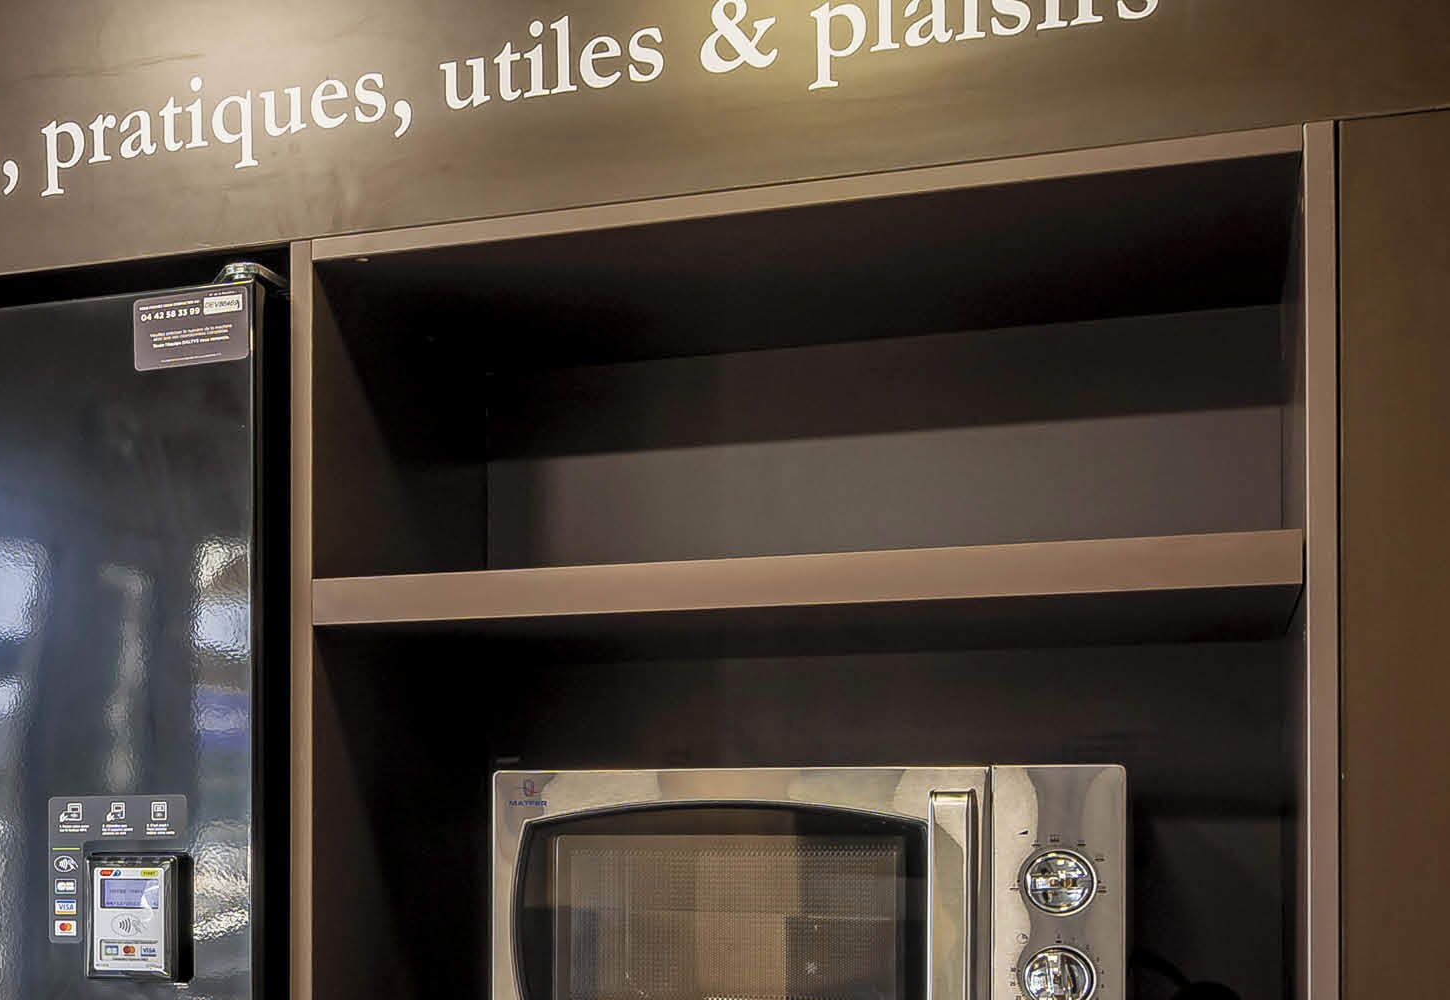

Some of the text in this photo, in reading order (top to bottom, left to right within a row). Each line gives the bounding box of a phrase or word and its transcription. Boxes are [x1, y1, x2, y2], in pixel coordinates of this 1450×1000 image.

[41, 72, 413, 197] pratiques,
[439, 20, 665, 110] utiles
[699, 0, 778, 74] &
[141, 314, 152, 322] 04
[154, 312, 165, 320] 42
[166, 310, 176, 318] 58
[178, 308, 188, 317] 33
[58, 902, 74, 912] VISA
